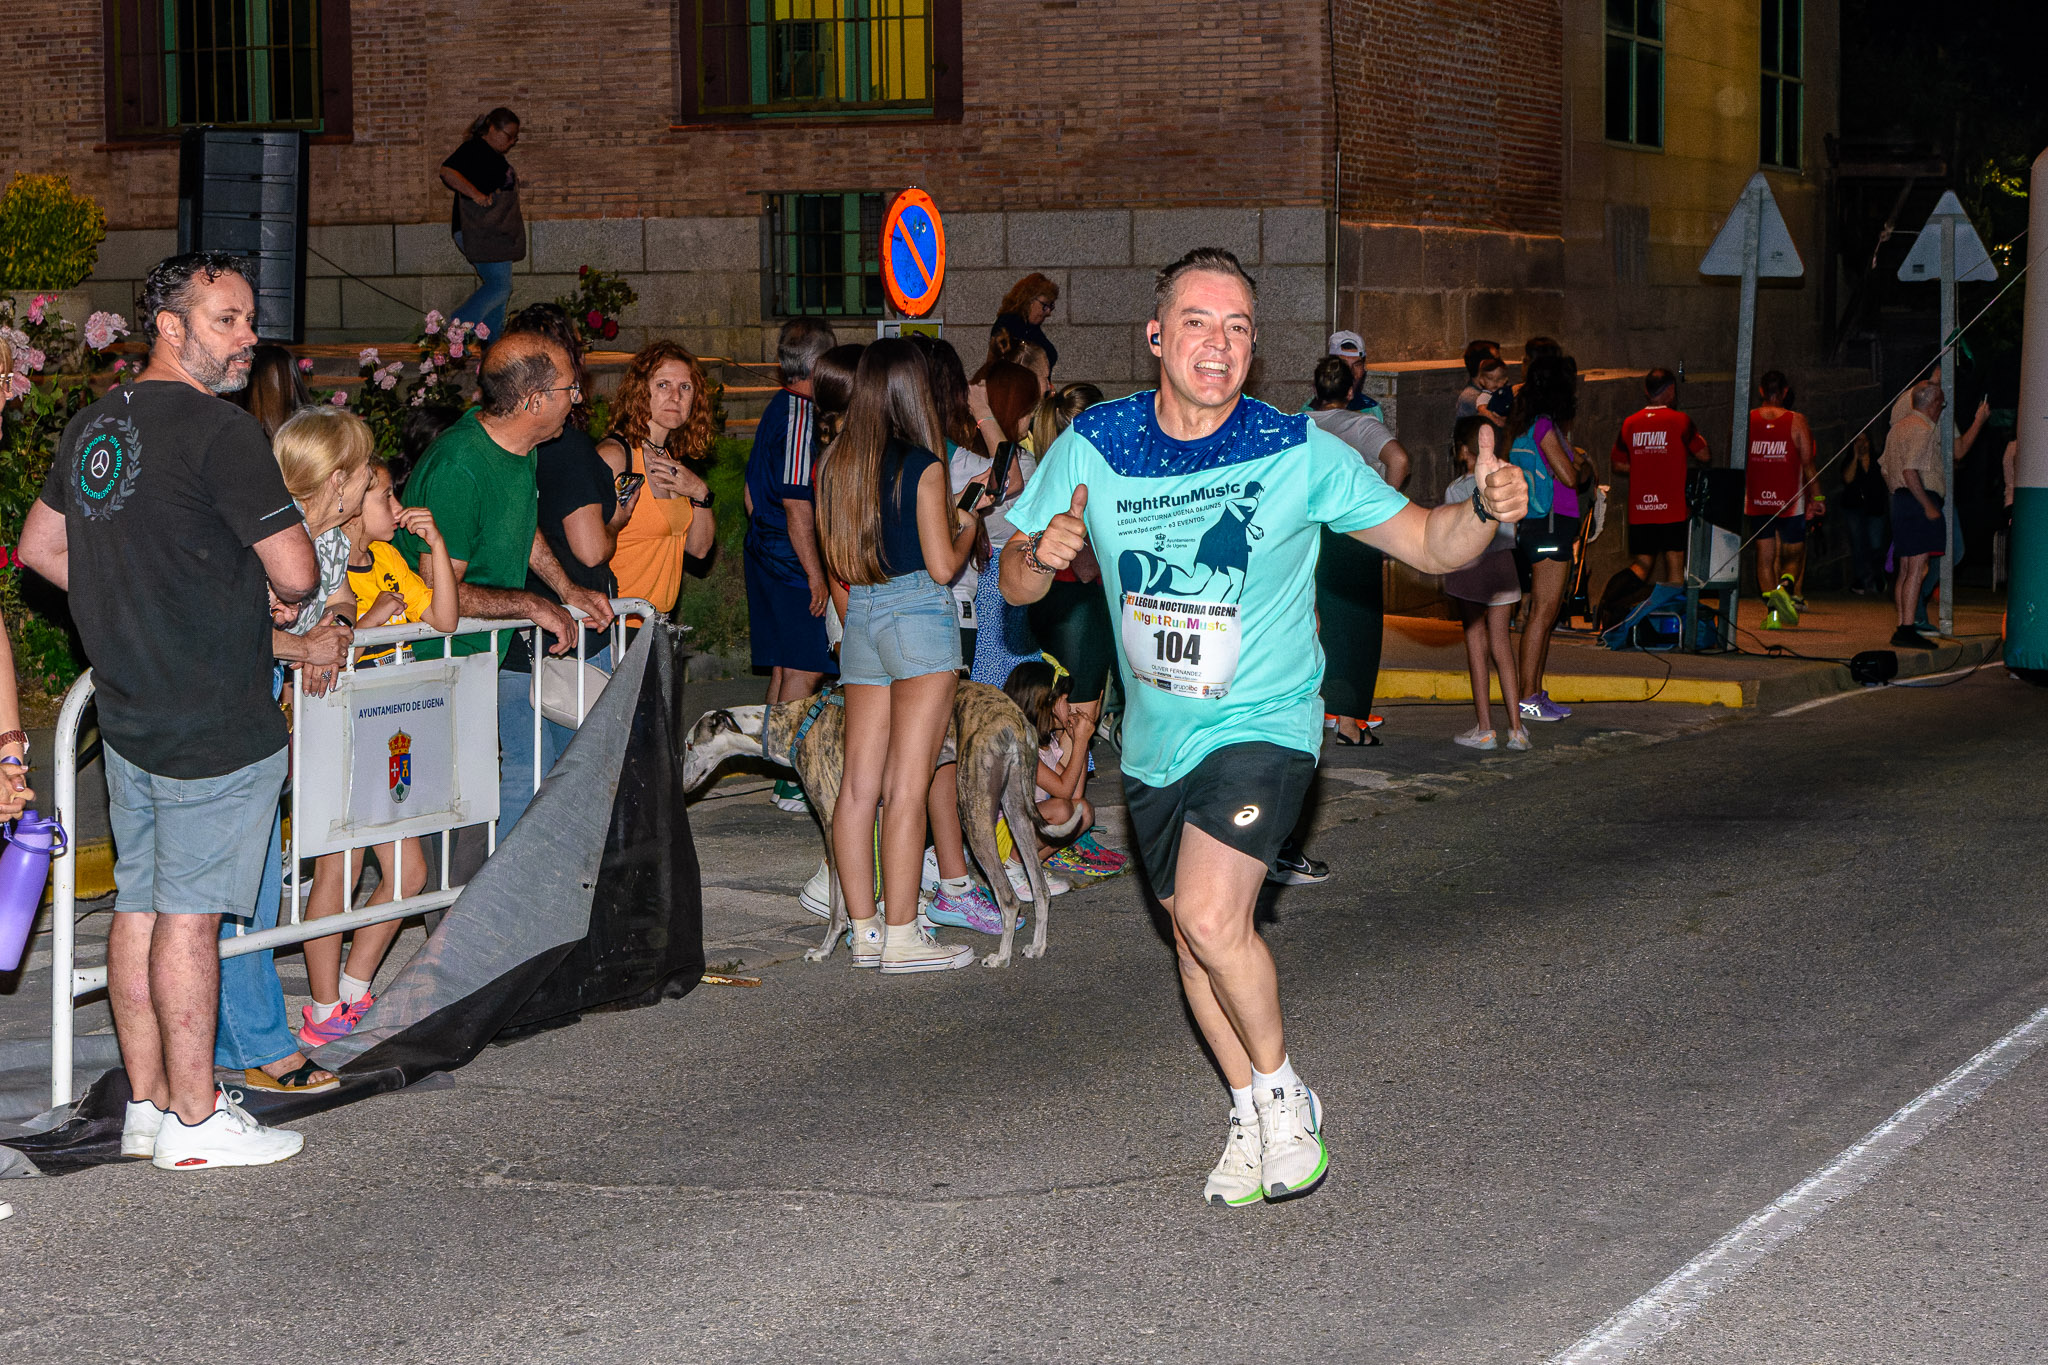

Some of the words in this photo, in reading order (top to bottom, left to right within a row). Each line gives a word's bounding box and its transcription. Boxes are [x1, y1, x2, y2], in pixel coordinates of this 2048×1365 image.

[113, 448, 122, 478] WORLD
[1116, 482, 1241, 514] NightRunMusic
[1643, 494, 1659, 503] CDA
[1761, 490, 1777, 499] CDA
[1117, 517, 1137, 527] LEGUA
[1138, 512, 1172, 523] NOCTURNA
[1173, 508, 1195, 517] UGENA
[1177, 516, 1205, 527] EVENTOS
[1135, 596, 1158, 610] LEGUA
[1159, 600, 1207, 616] NOCTURNA
[1208, 605, 1237, 618] UGENA
[1153, 629, 1202, 666] 104
[1152, 664, 1169, 673] OLIVER
[1169, 667, 1202, 678] FERNANDEZ
[358, 702, 411, 719] AYUNTAMIENTO
[412, 700, 421, 711] DE
[422, 697, 445, 709] UGENA
